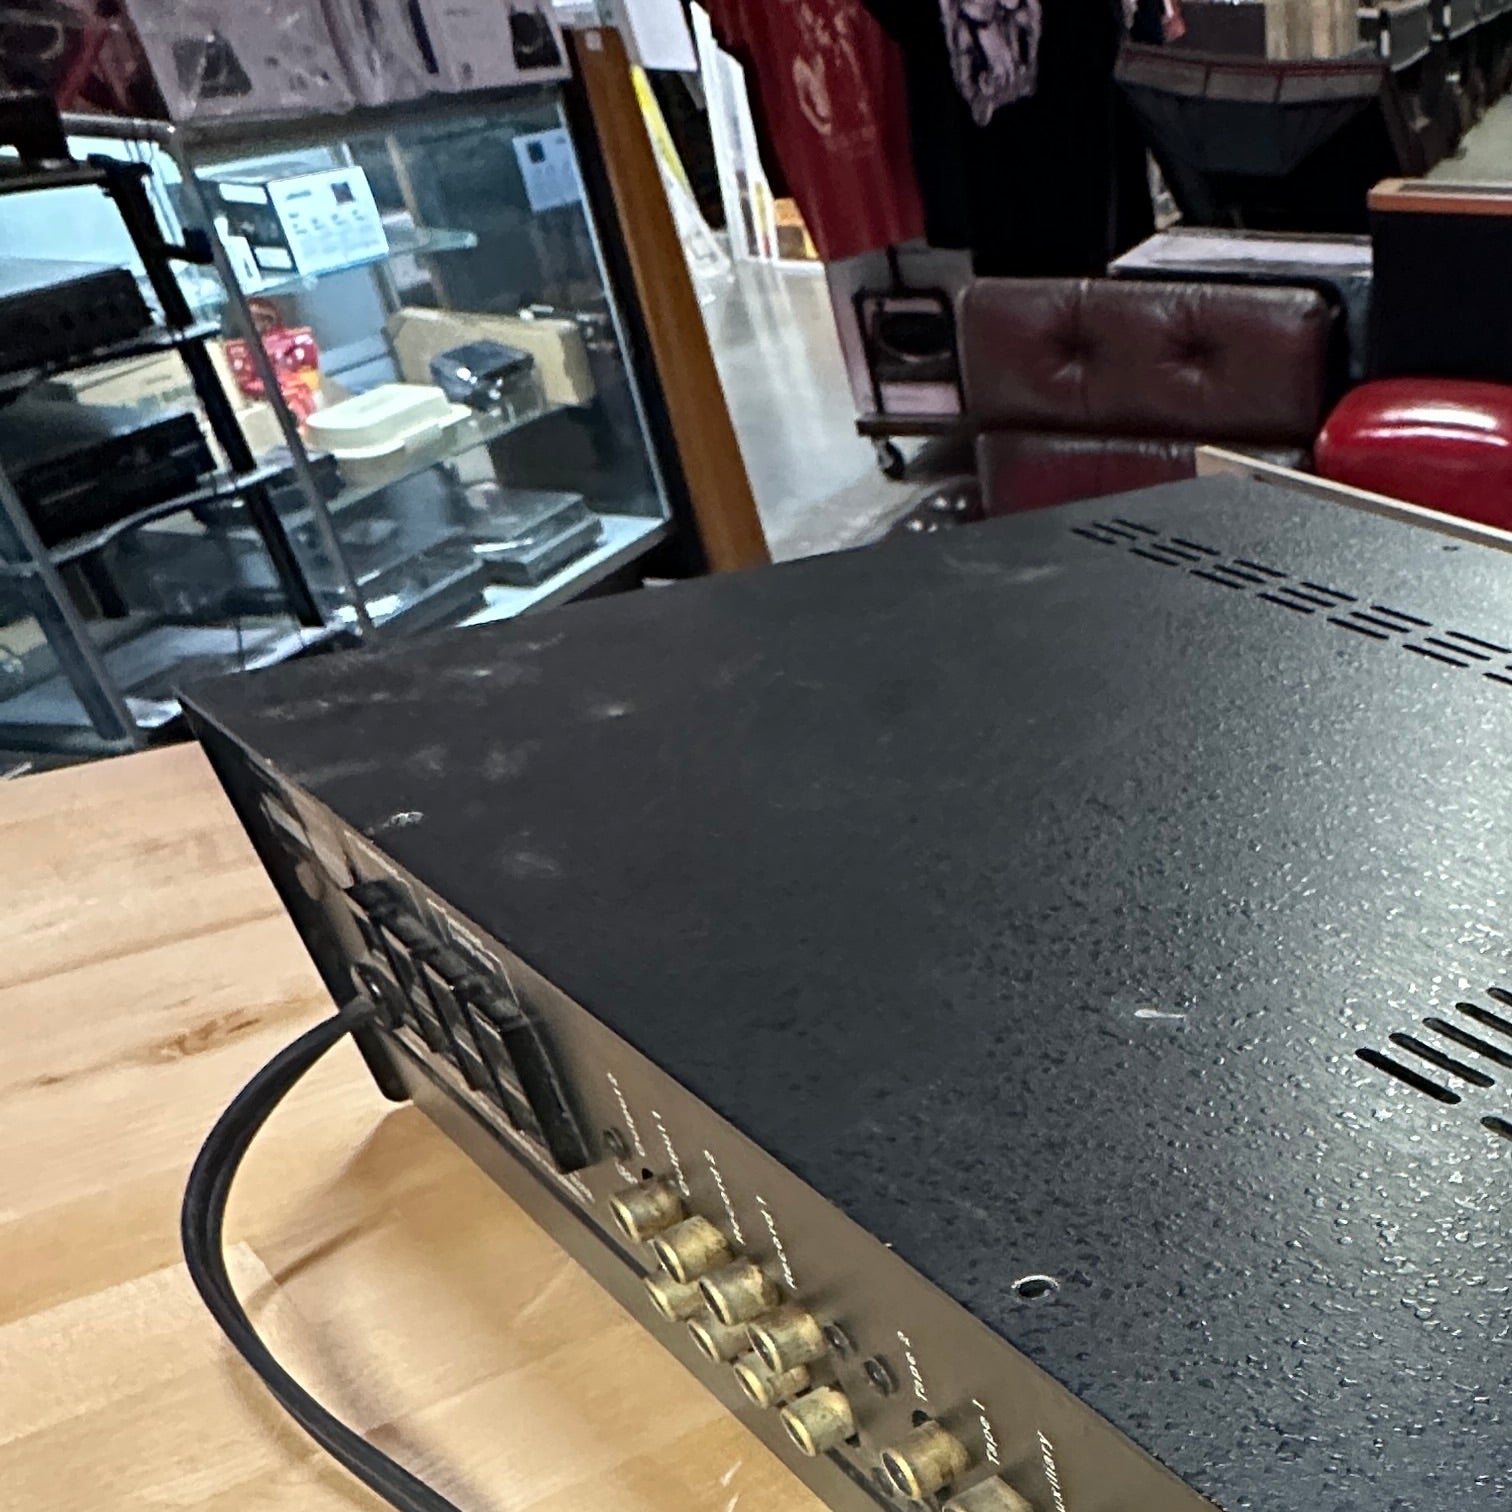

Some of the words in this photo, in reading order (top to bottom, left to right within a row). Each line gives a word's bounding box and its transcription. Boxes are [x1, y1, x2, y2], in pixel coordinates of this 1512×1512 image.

[898, 1330, 910, 1347] 2
[906, 1352, 928, 1401] Tape
[980, 1416, 1000, 1466] Tape
